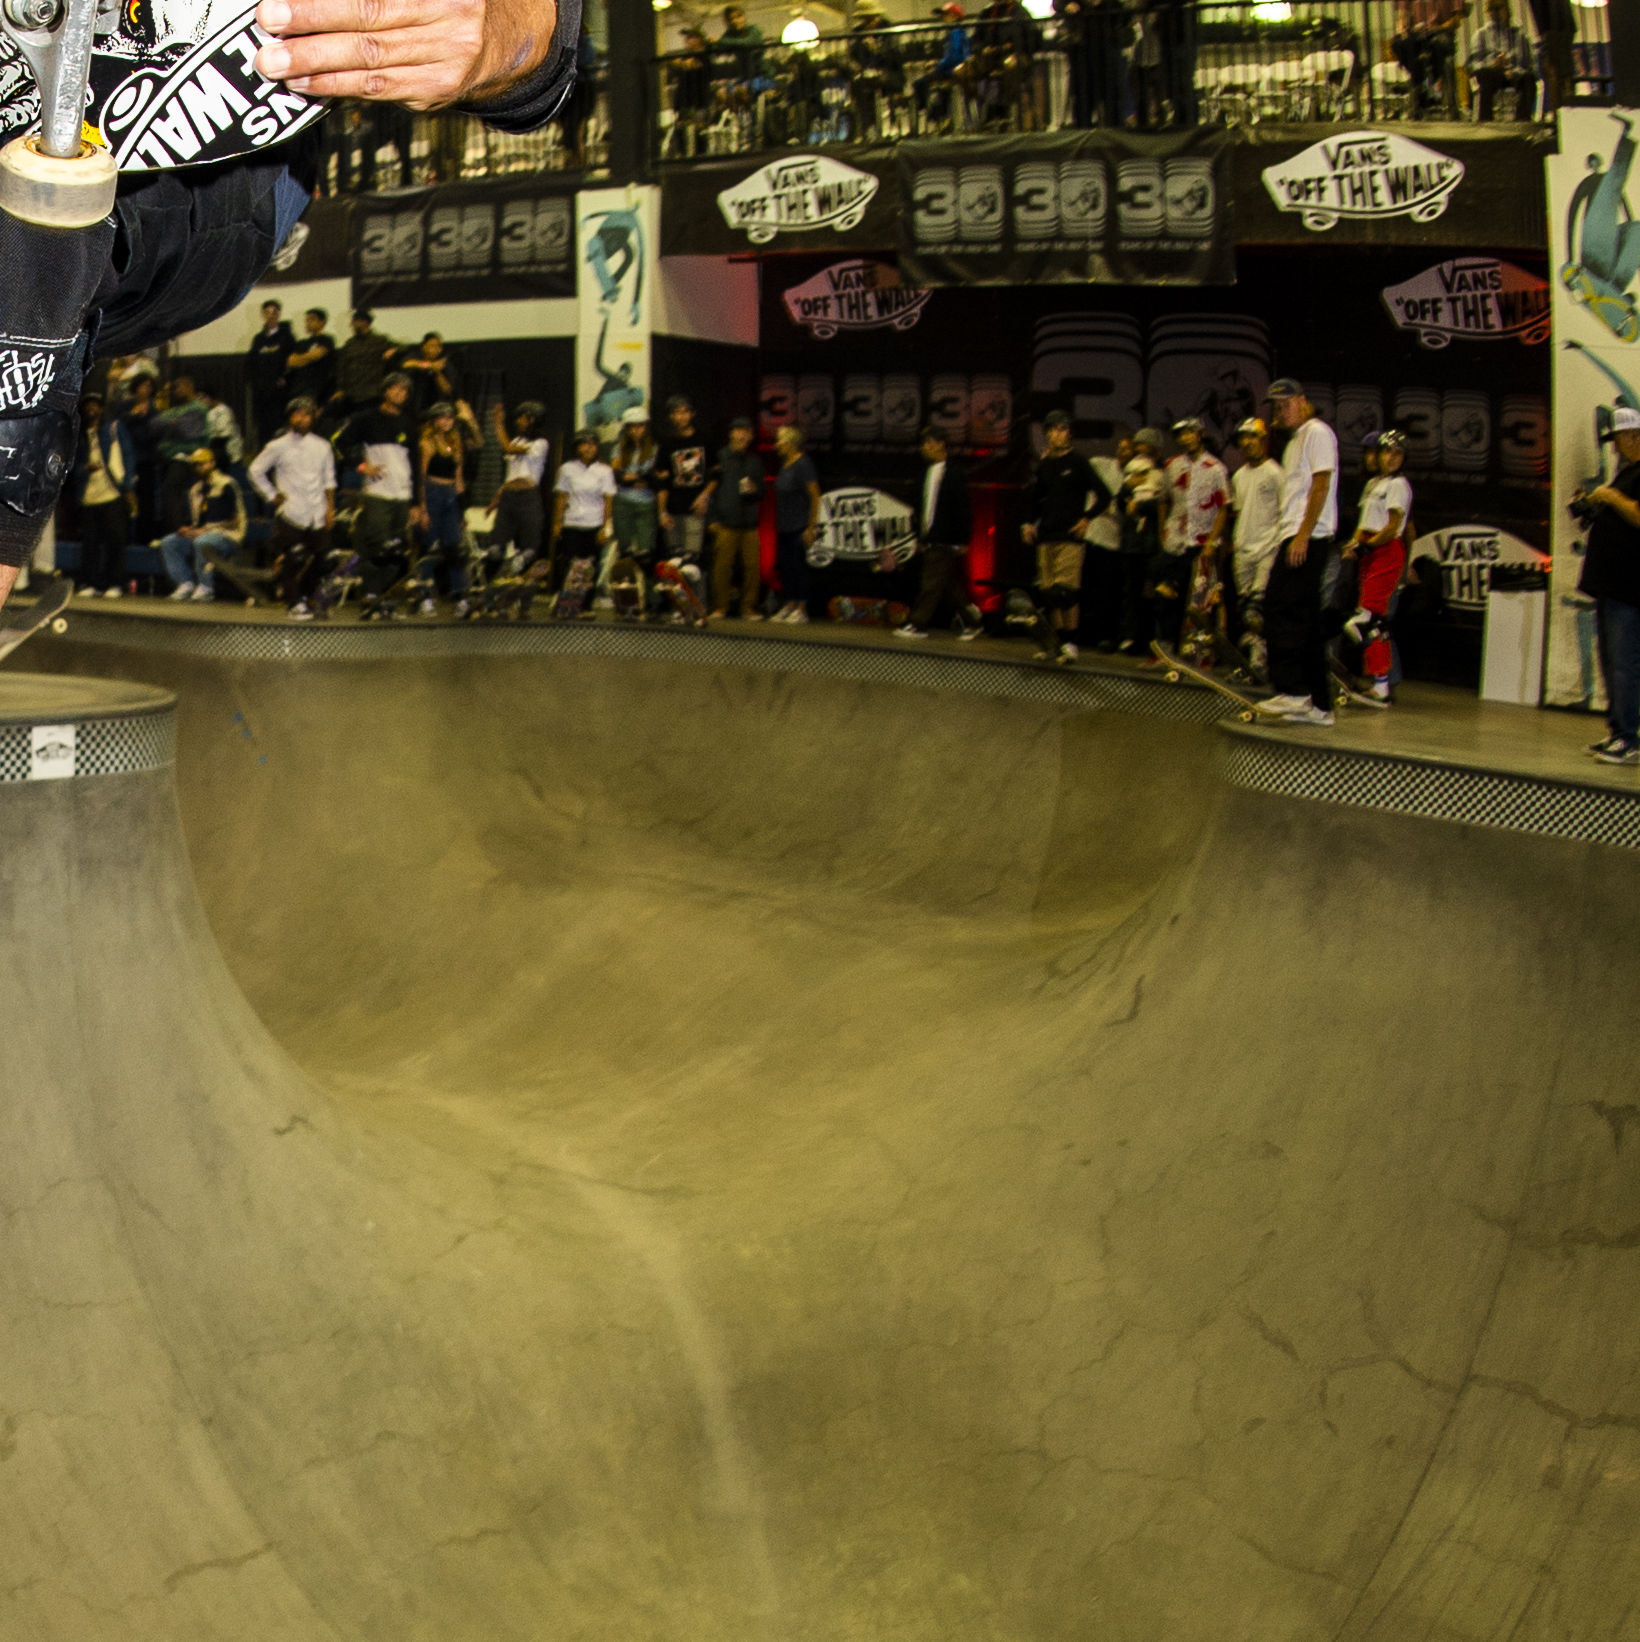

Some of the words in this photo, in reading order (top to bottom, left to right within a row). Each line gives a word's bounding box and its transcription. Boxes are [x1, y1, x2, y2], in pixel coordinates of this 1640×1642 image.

[1322, 135, 1391, 171] VANS
[765, 160, 821, 189] VANS
[1332, 169, 1384, 207] THE
[773, 189, 812, 220] THE
[1438, 260, 1502, 293] VANS
[835, 290, 872, 320] THE
[1446, 293, 1495, 330] THE
[823, 492, 876, 518] VANS
[831, 519, 867, 550] THE
[1434, 532, 1500, 561] VANS
